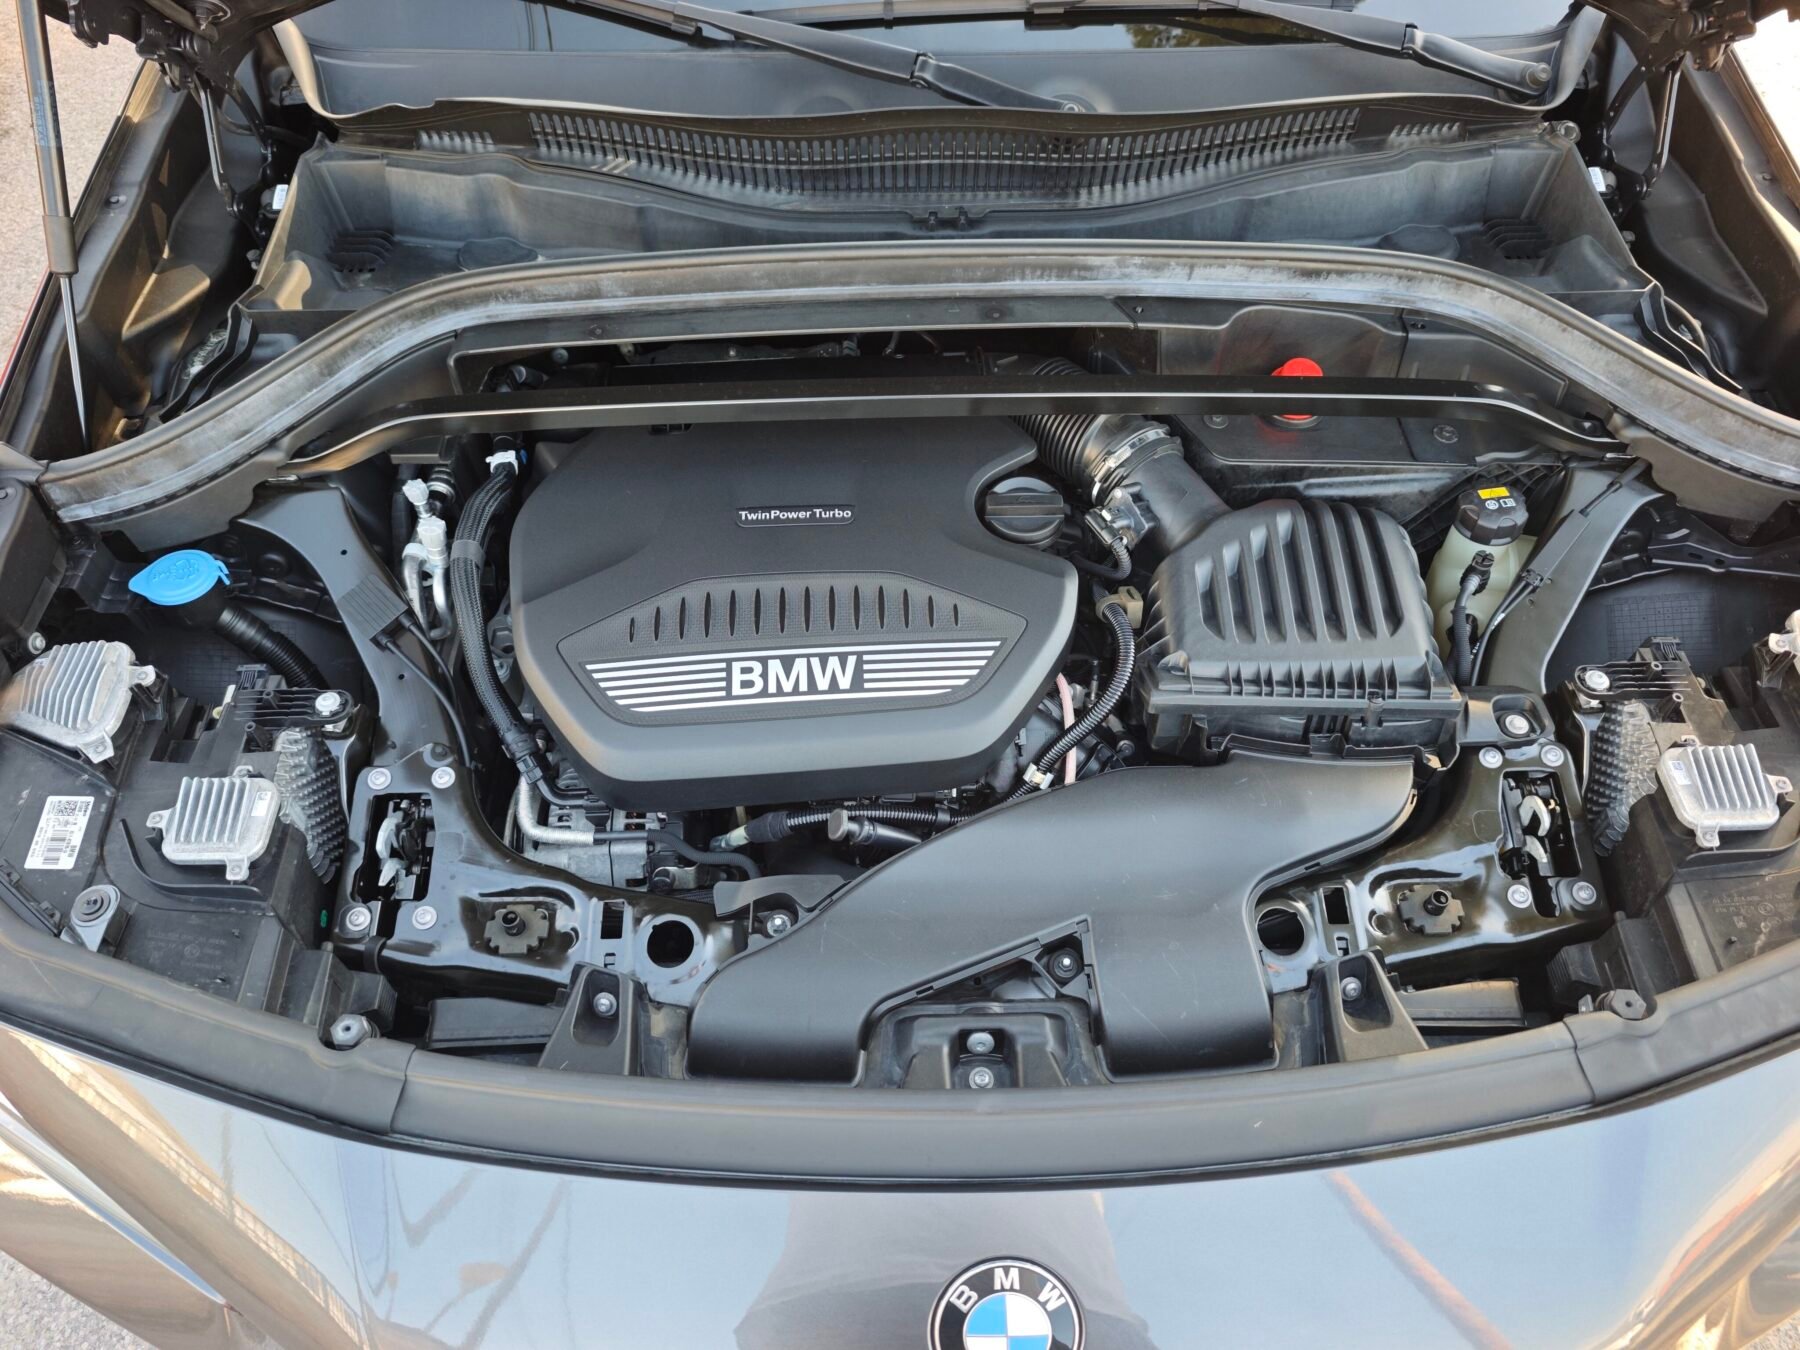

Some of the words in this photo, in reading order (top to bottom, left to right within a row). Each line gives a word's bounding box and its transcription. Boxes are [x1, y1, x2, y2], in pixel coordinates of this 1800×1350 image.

[739, 509, 812, 521] TwinPower
[813, 508, 852, 518] Turbo
[731, 655, 857, 696] BMW
[950, 1267, 1066, 1314] BMW
